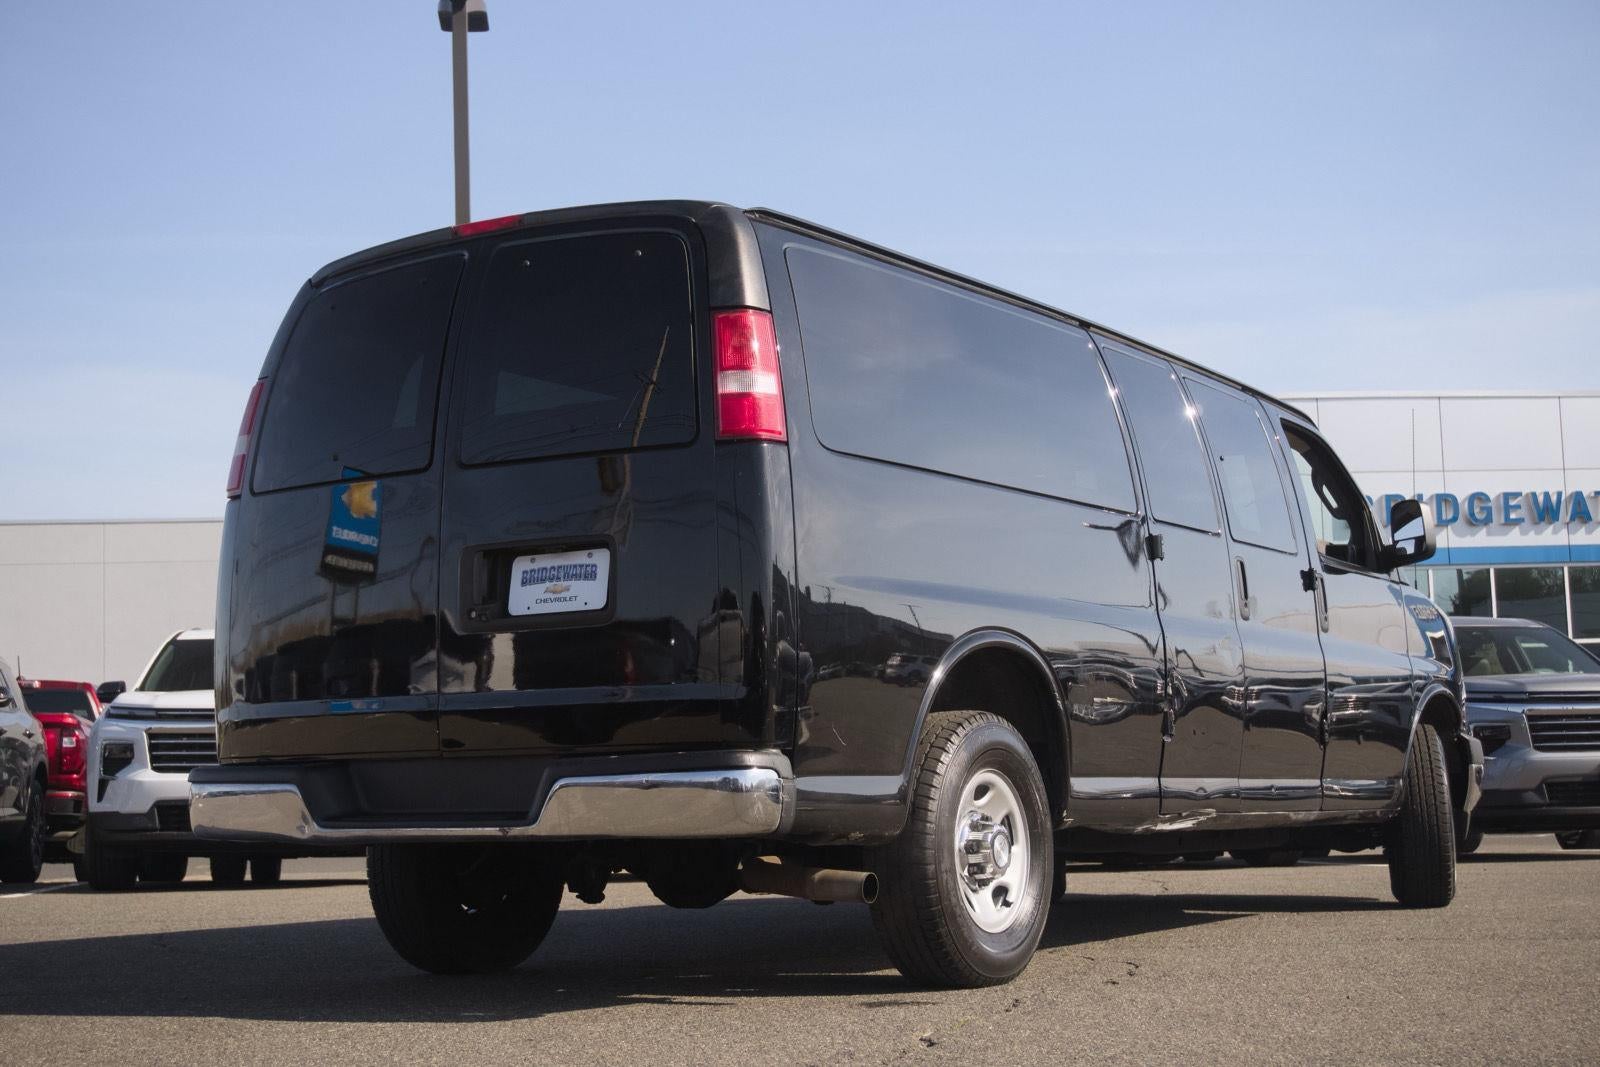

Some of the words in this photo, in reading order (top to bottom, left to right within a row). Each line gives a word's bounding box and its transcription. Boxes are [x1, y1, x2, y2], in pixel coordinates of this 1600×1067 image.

[1365, 490, 1600, 527] DGEWA
[520, 563, 598, 587] BRIDGEWATER
[535, 595, 578, 604] CHEVROLET
